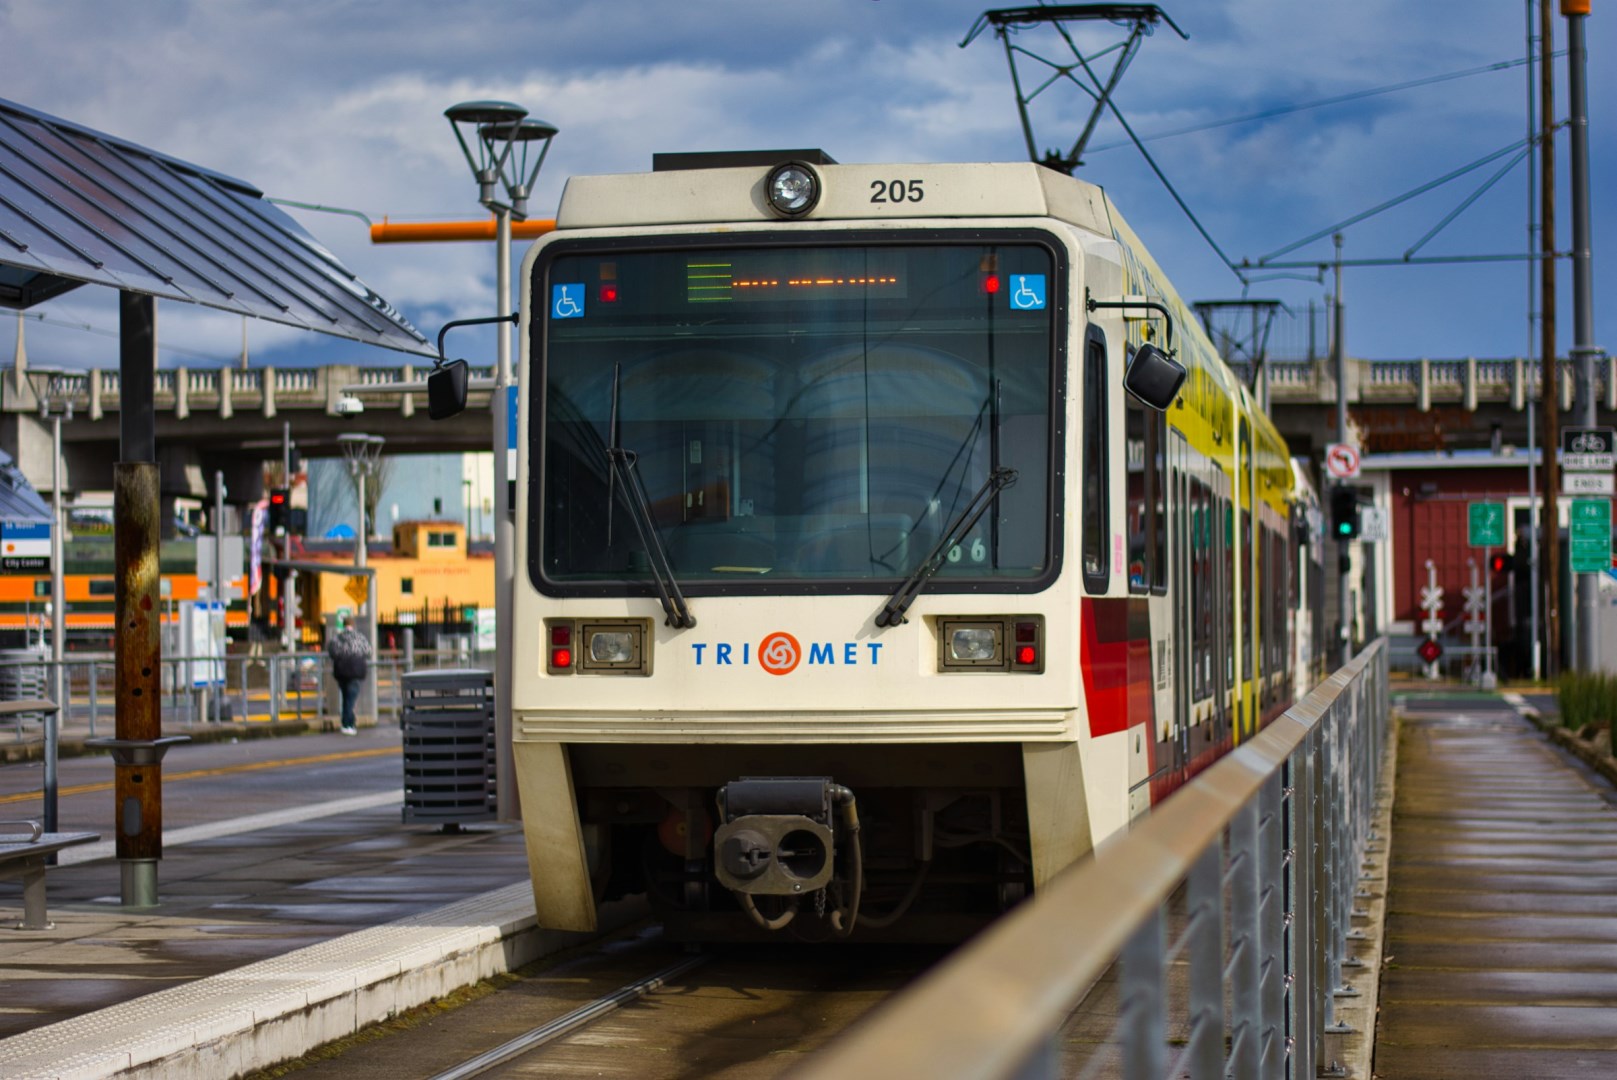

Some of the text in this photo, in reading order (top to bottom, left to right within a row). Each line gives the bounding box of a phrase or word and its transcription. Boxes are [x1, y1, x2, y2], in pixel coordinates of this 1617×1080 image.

[870, 179, 924, 204] 205
[692, 642, 884, 665] TRI MET
